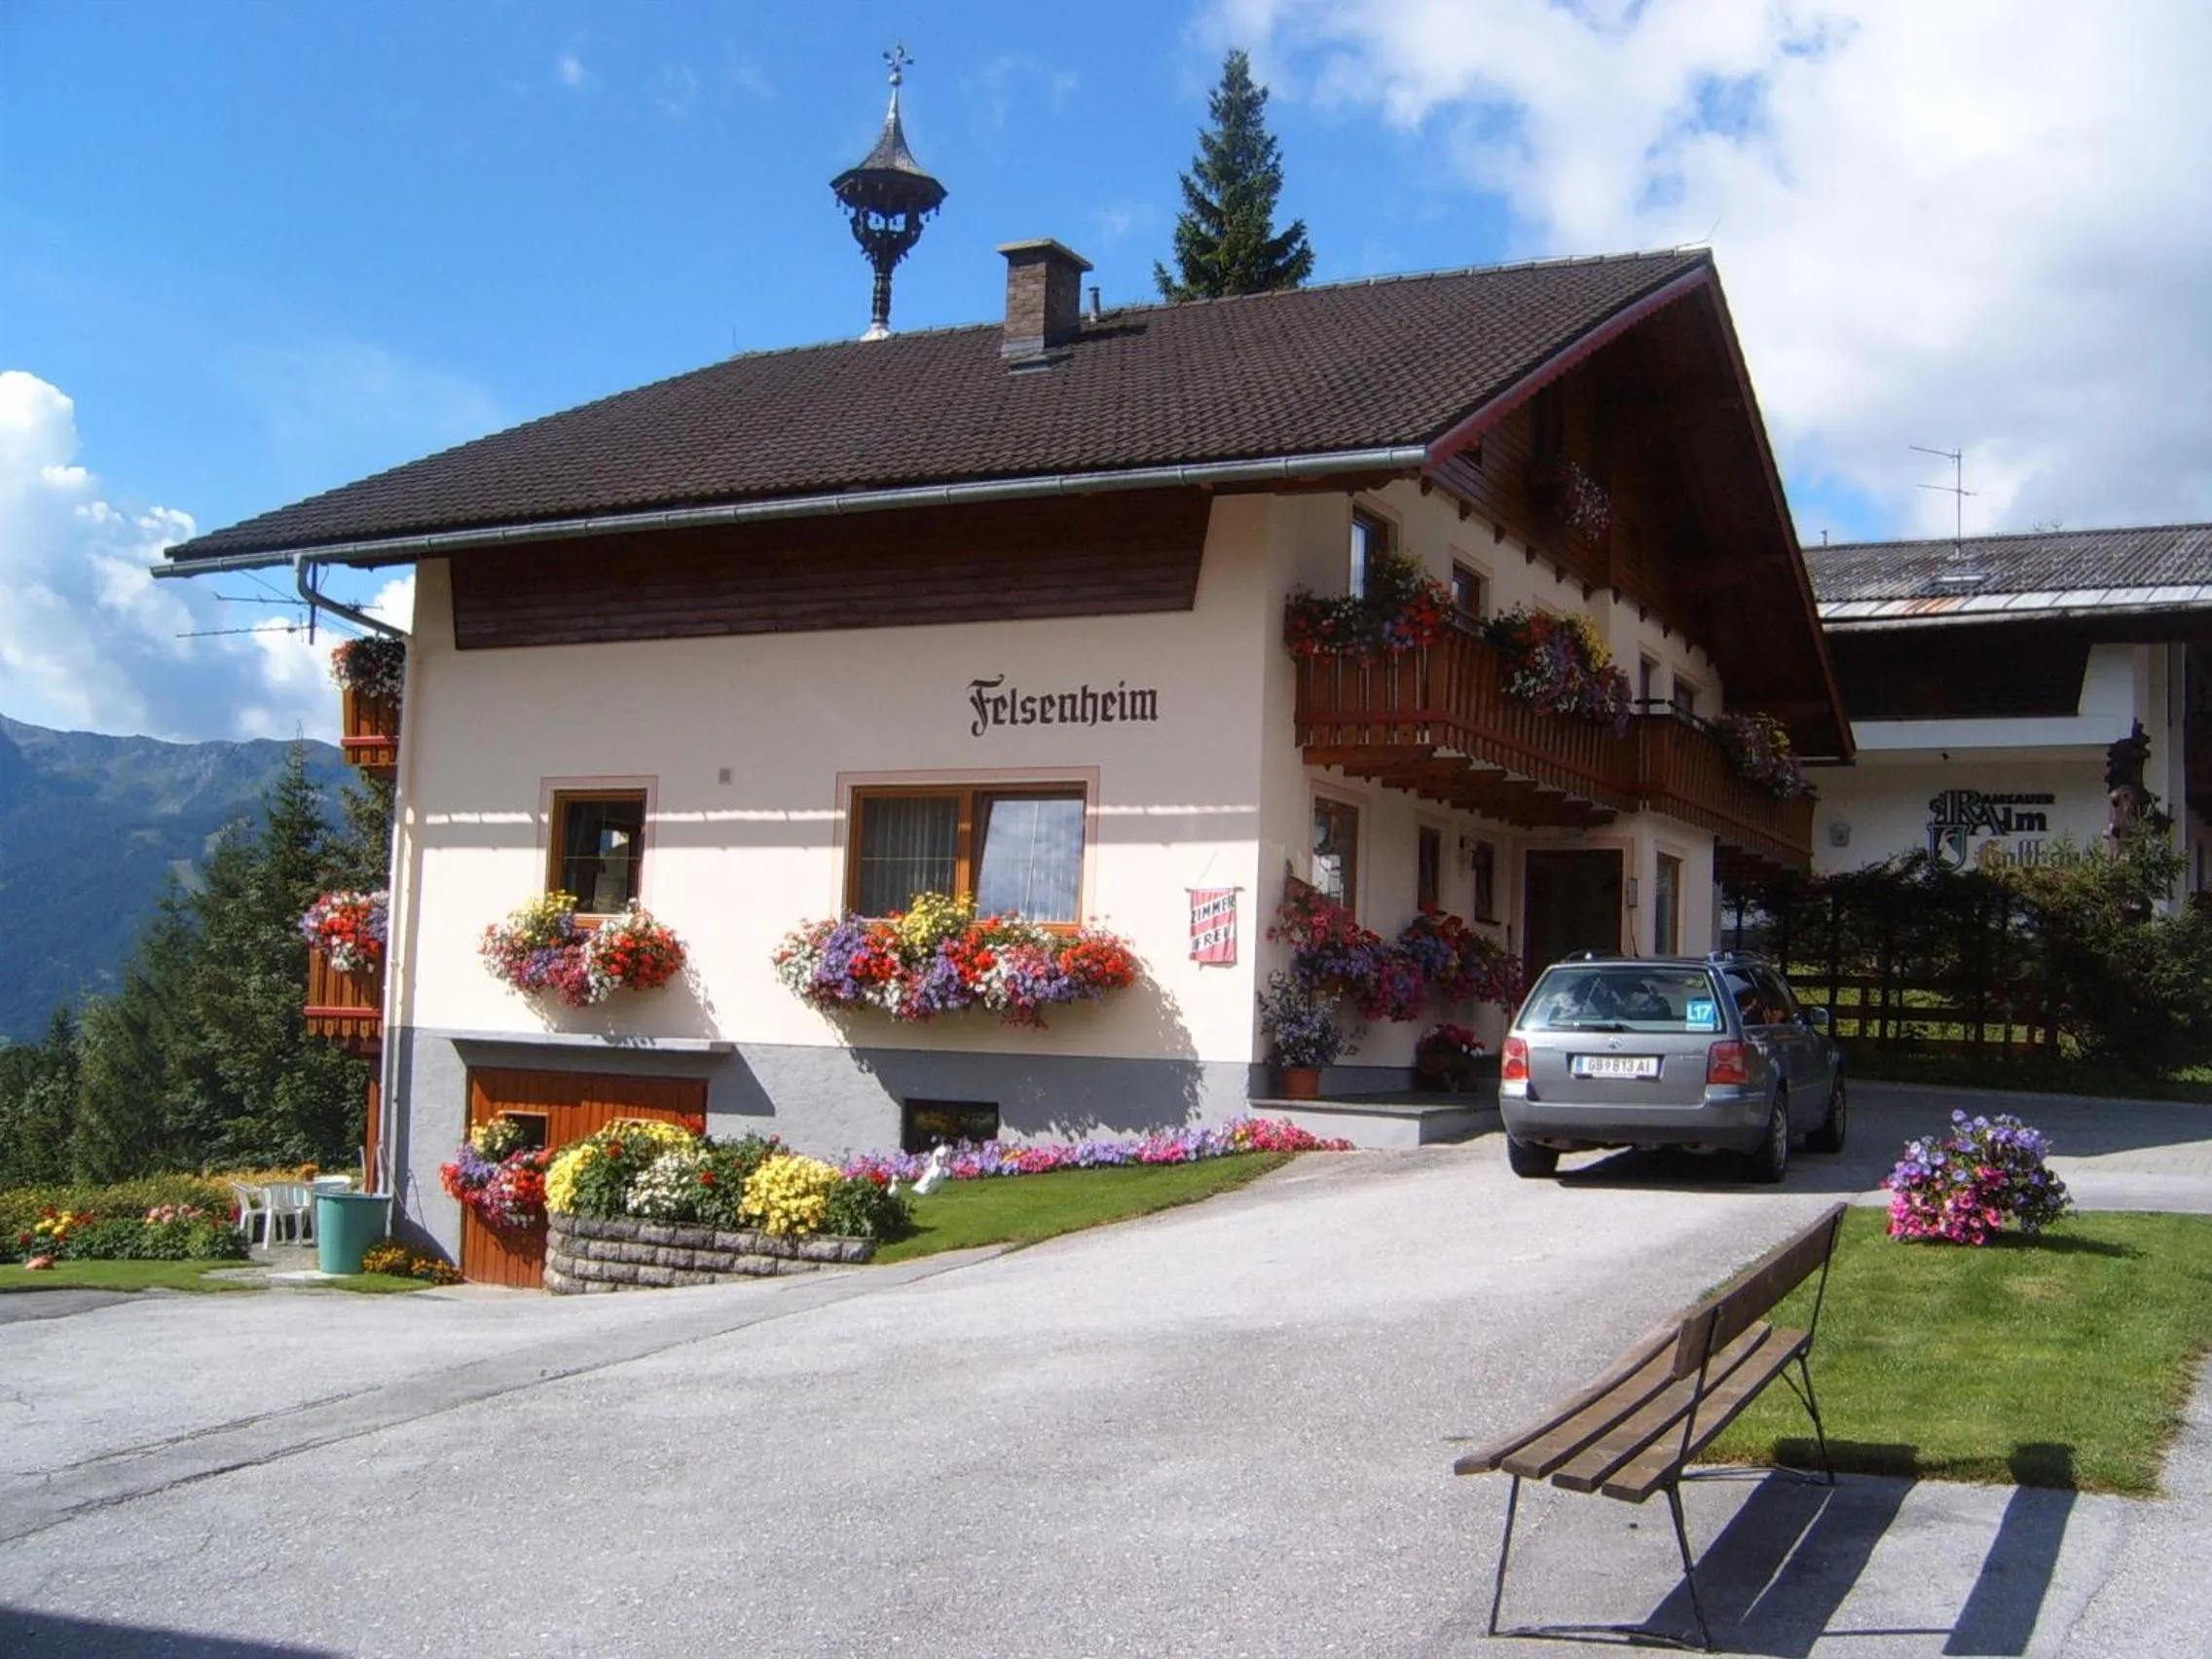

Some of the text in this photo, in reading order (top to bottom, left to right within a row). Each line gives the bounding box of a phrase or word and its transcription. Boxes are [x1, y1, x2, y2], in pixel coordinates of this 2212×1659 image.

[968, 674, 1159, 737] Felsenheim
[1191, 894, 1235, 924] ZIMMER
[1686, 1004, 1713, 1021] L17
